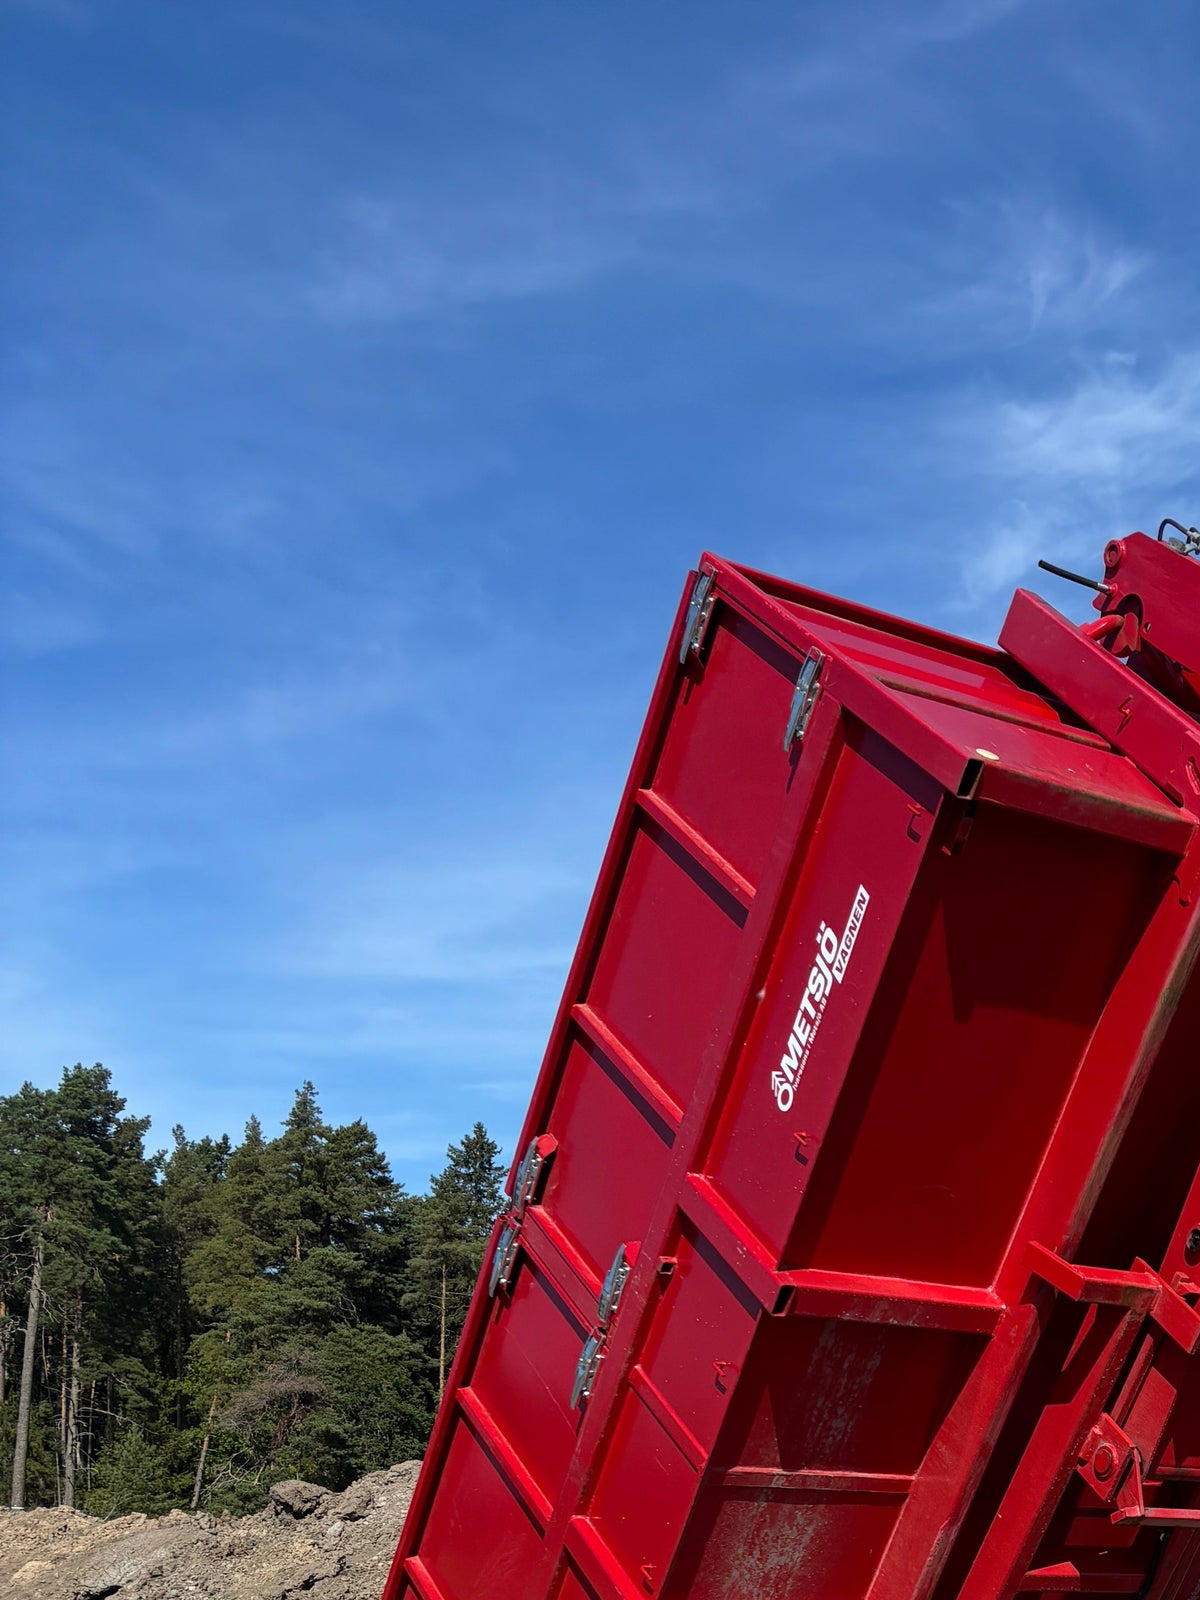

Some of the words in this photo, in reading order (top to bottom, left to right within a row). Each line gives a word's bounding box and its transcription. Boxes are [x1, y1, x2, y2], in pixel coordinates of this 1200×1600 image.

[834, 891, 868, 975] VAGNEN
[780, 920, 838, 1083] METSJÖ
[820, 996, 827, 1012] AB
